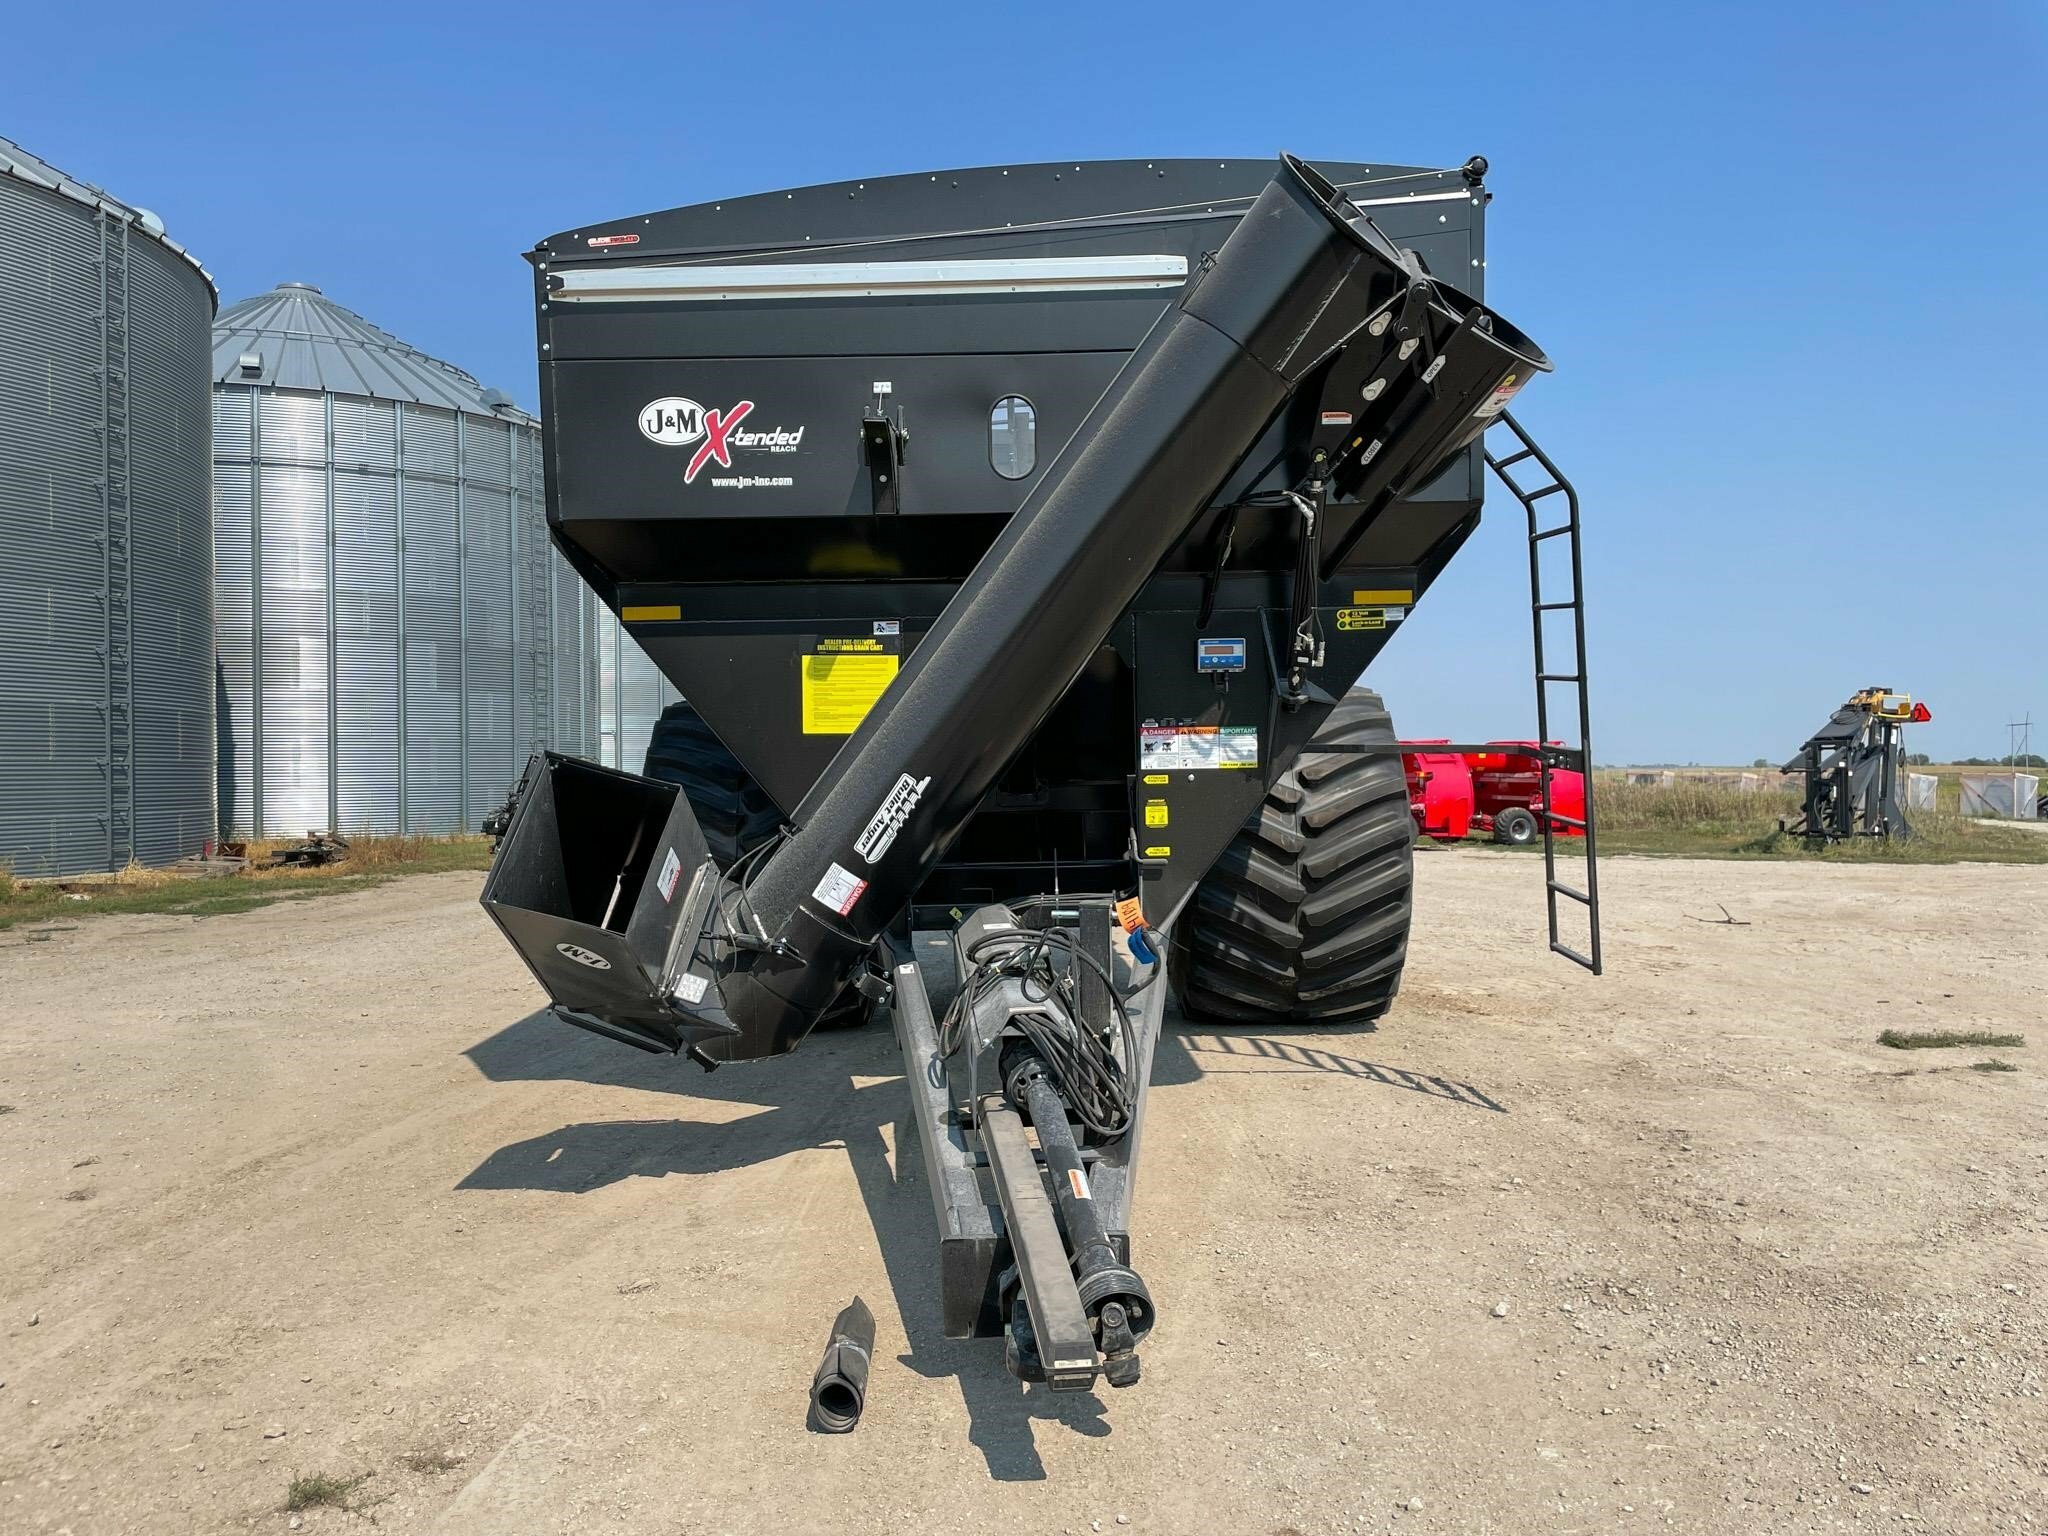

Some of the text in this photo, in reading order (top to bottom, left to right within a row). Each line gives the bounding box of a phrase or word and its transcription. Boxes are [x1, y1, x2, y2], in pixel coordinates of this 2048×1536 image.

[1426, 362, 1440, 378] OPEN
[647, 408, 698, 434] J&M
[1363, 441, 1380, 463] CLOSED
[711, 476, 793, 488] www.jm-inc.com
[861, 780, 910, 851] Bullet Auger
[841, 884, 864, 915] DANGER
[562, 945, 609, 968] J&M
